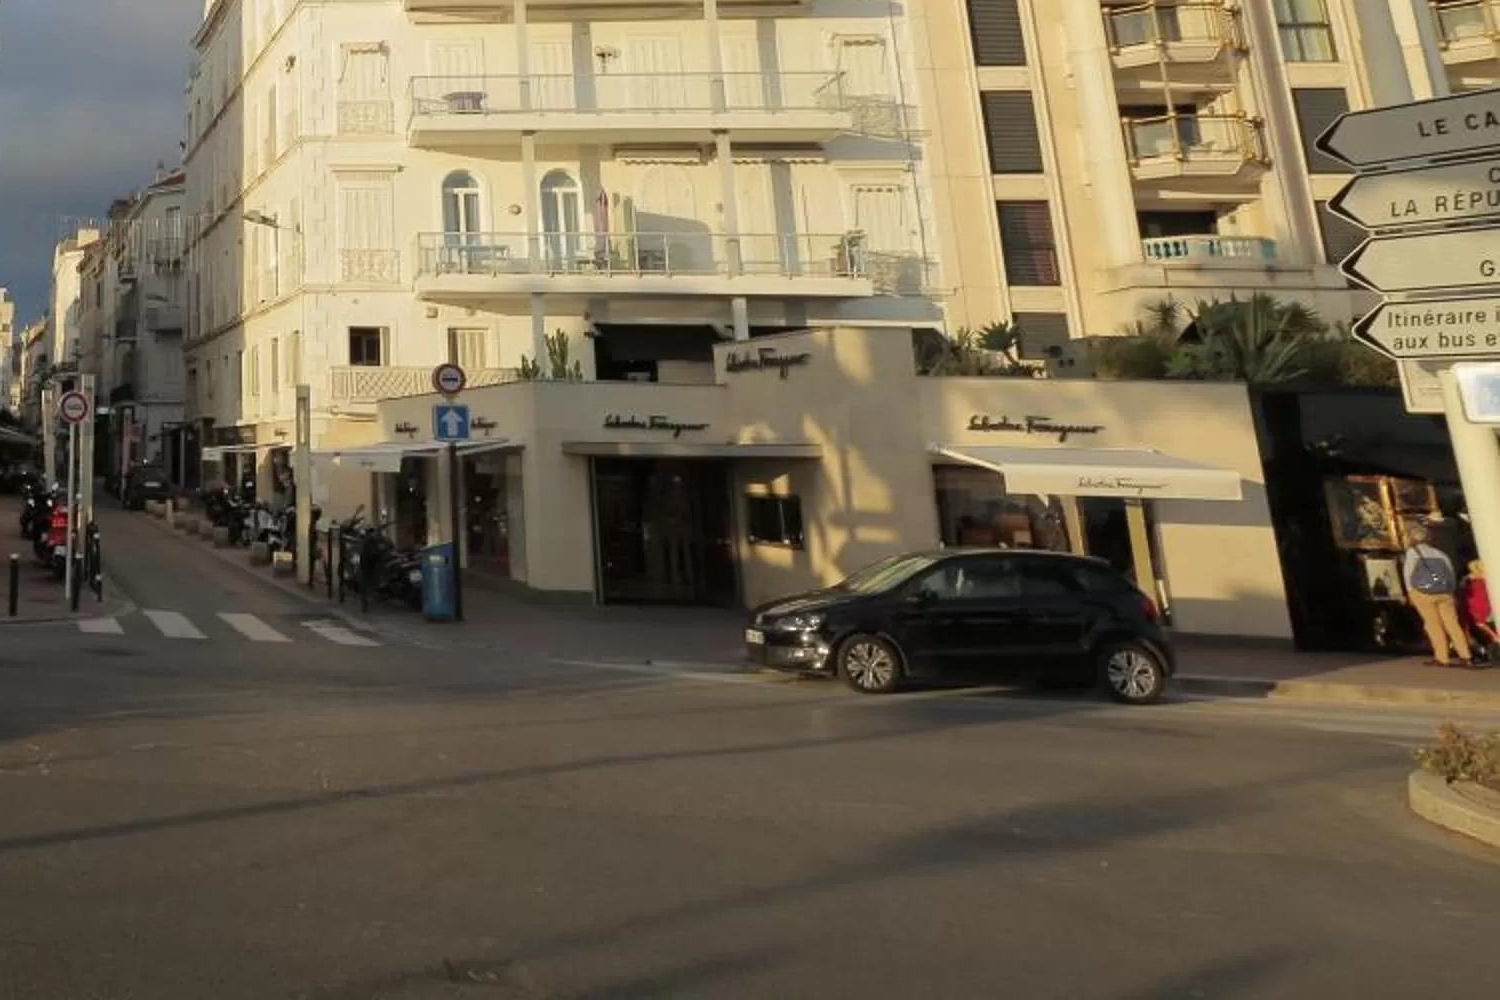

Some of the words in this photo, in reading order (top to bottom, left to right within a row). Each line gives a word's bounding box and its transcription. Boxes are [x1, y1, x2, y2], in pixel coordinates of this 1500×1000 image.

[1417, 118, 1449, 137] LE
[1391, 199, 1419, 217] LA
[1387, 308, 1487, 328] Itinéraire
[1393, 336, 1428, 350] aux
[1438, 332, 1476, 349] bus
